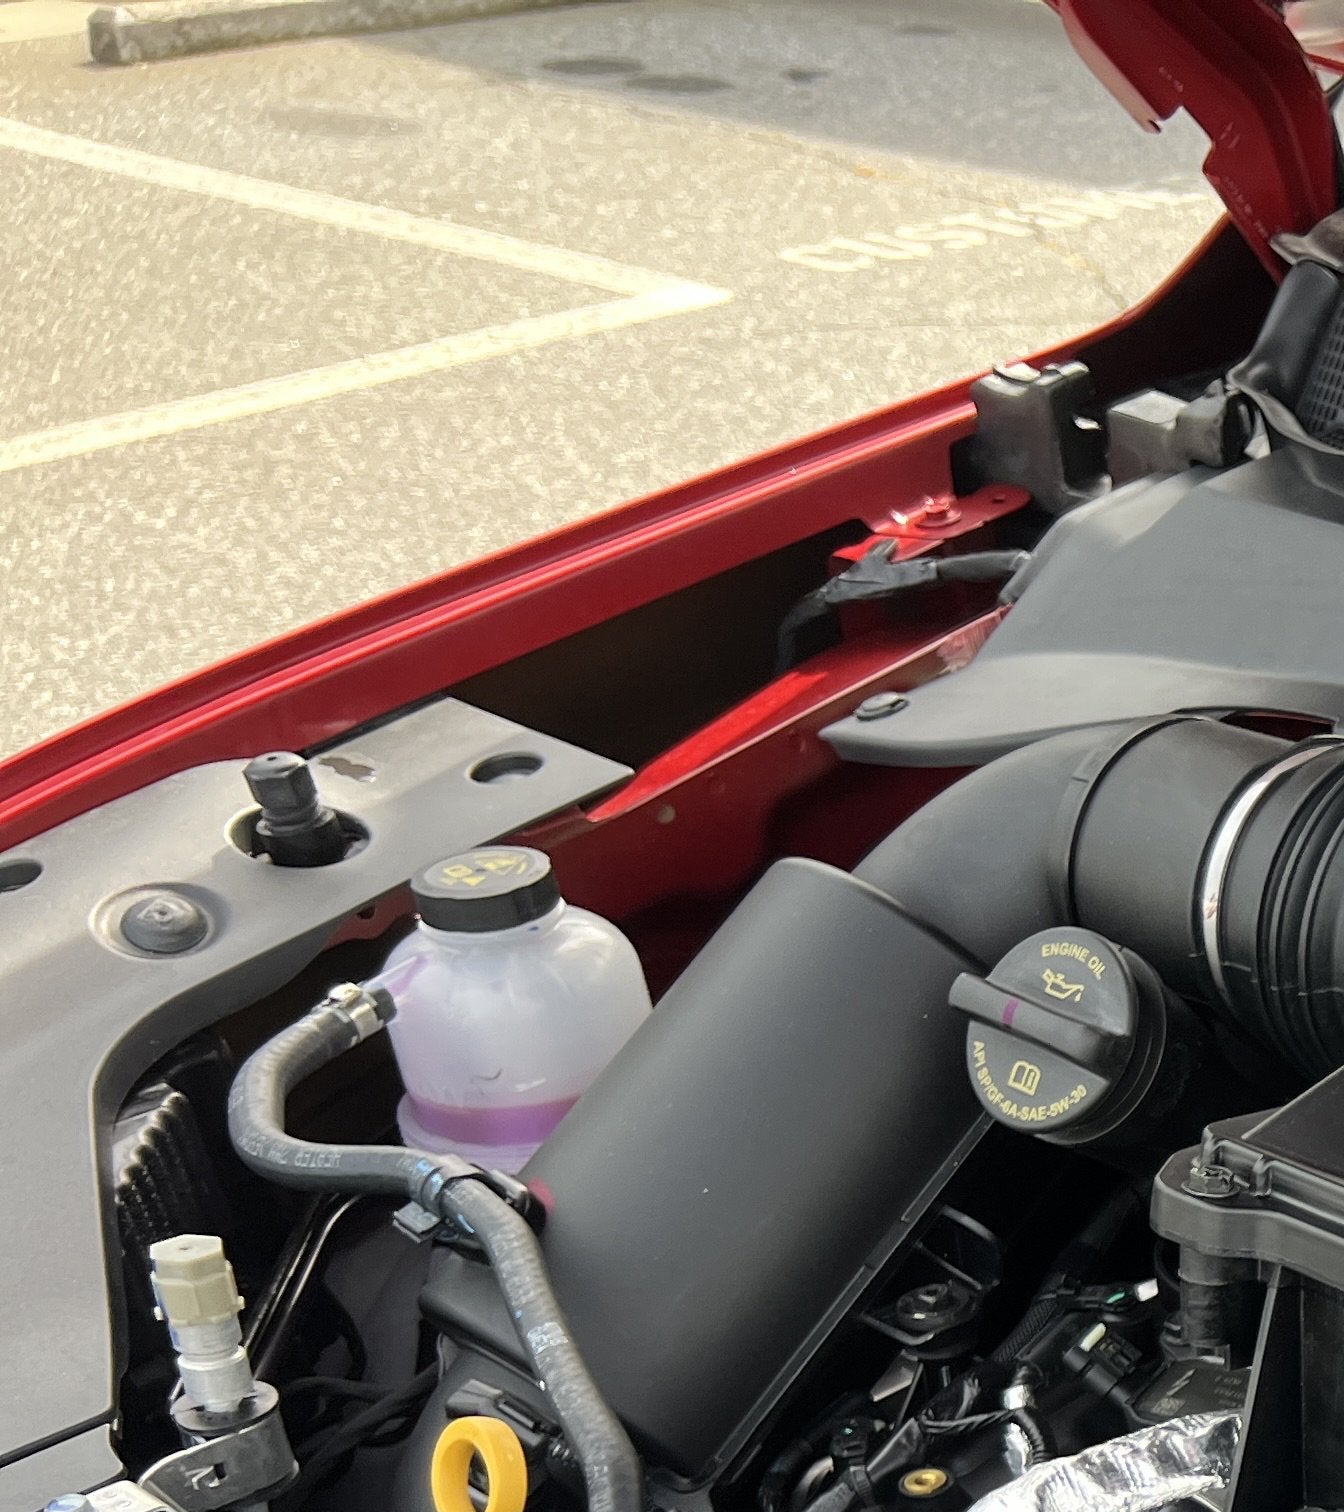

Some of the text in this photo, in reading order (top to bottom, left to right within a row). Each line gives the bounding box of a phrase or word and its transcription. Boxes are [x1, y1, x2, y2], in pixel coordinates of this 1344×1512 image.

[1041, 942, 1106, 979] ENGINE OIL
[974, 1040, 985, 1066] API
